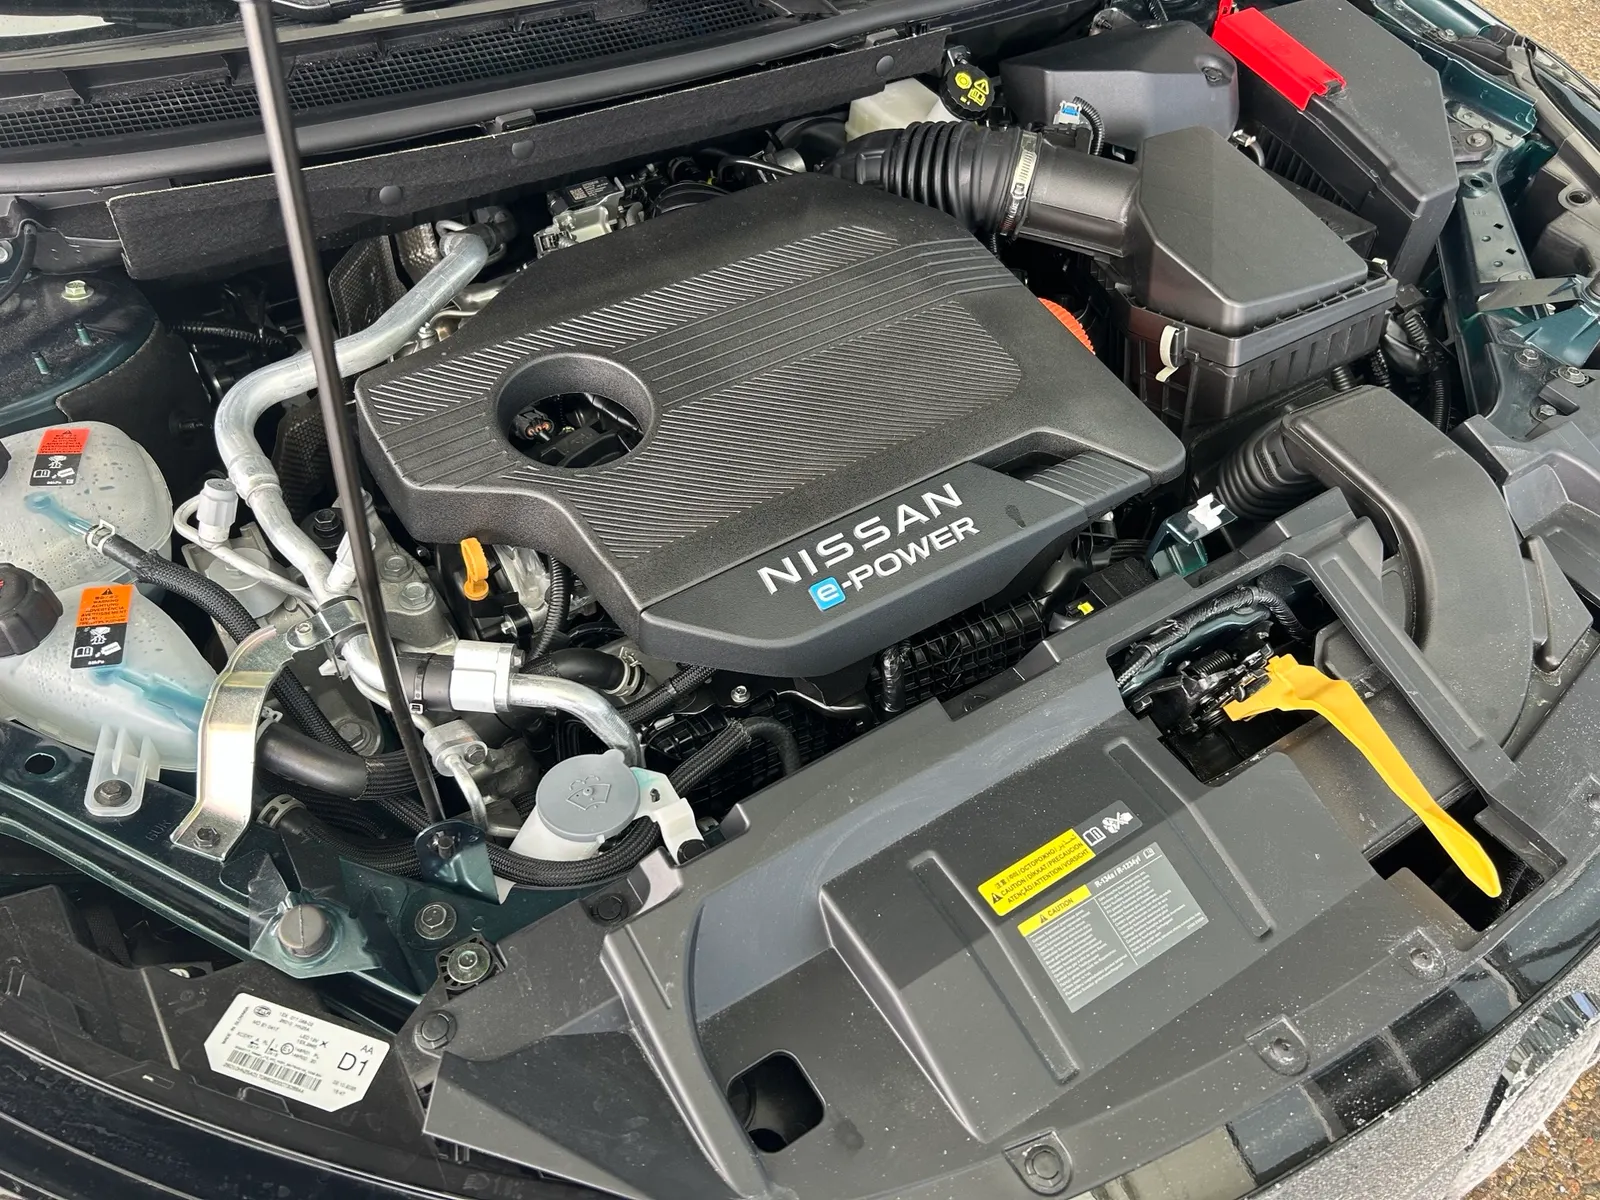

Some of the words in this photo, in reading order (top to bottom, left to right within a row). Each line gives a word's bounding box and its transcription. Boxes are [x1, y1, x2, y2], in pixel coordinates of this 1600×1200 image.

[757, 482, 963, 595] NISSAN
[810, 516, 980, 610] e-POWER
[1047, 897, 1075, 917] CAUTION
[360, 1044, 374, 1055] AA
[337, 1051, 369, 1076] D1
